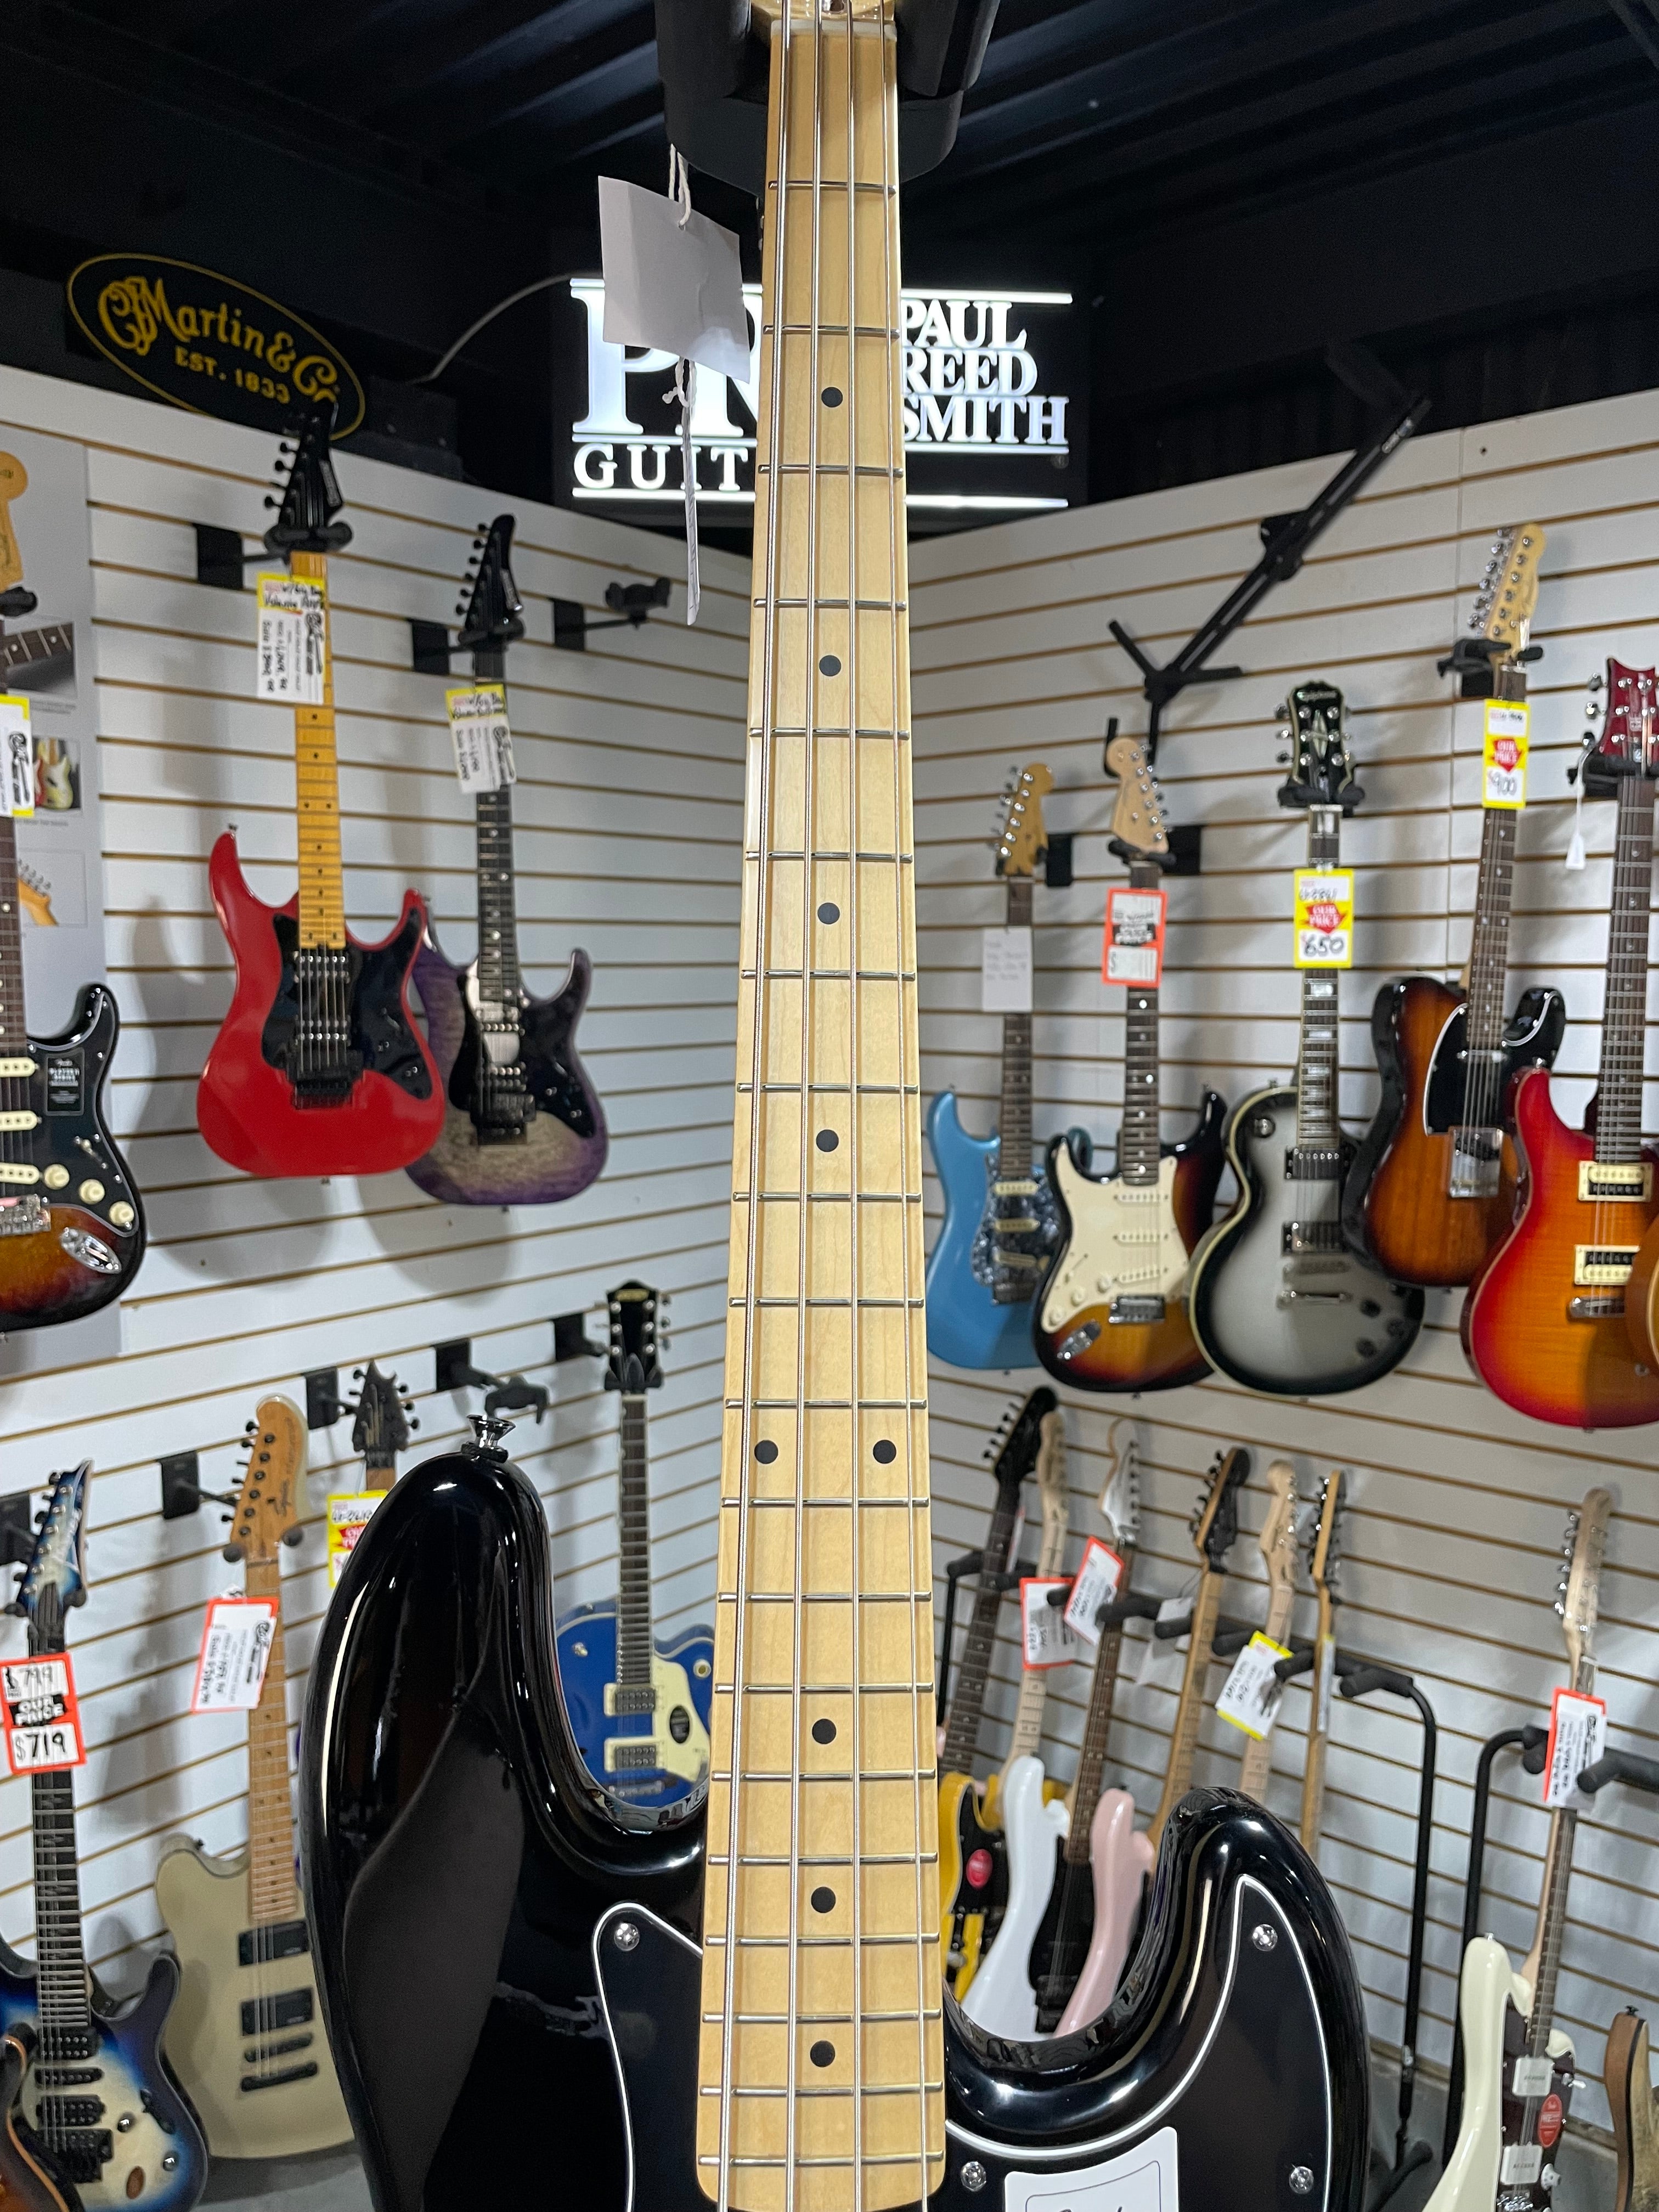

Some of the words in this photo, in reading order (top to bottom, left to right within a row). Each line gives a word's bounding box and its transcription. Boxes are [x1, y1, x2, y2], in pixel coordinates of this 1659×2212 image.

[901, 298, 1027, 349] PAUL
[902, 347, 1037, 397] REED
[904, 393, 1069, 444] SMITH
[573, 443, 749, 492] GUIT
